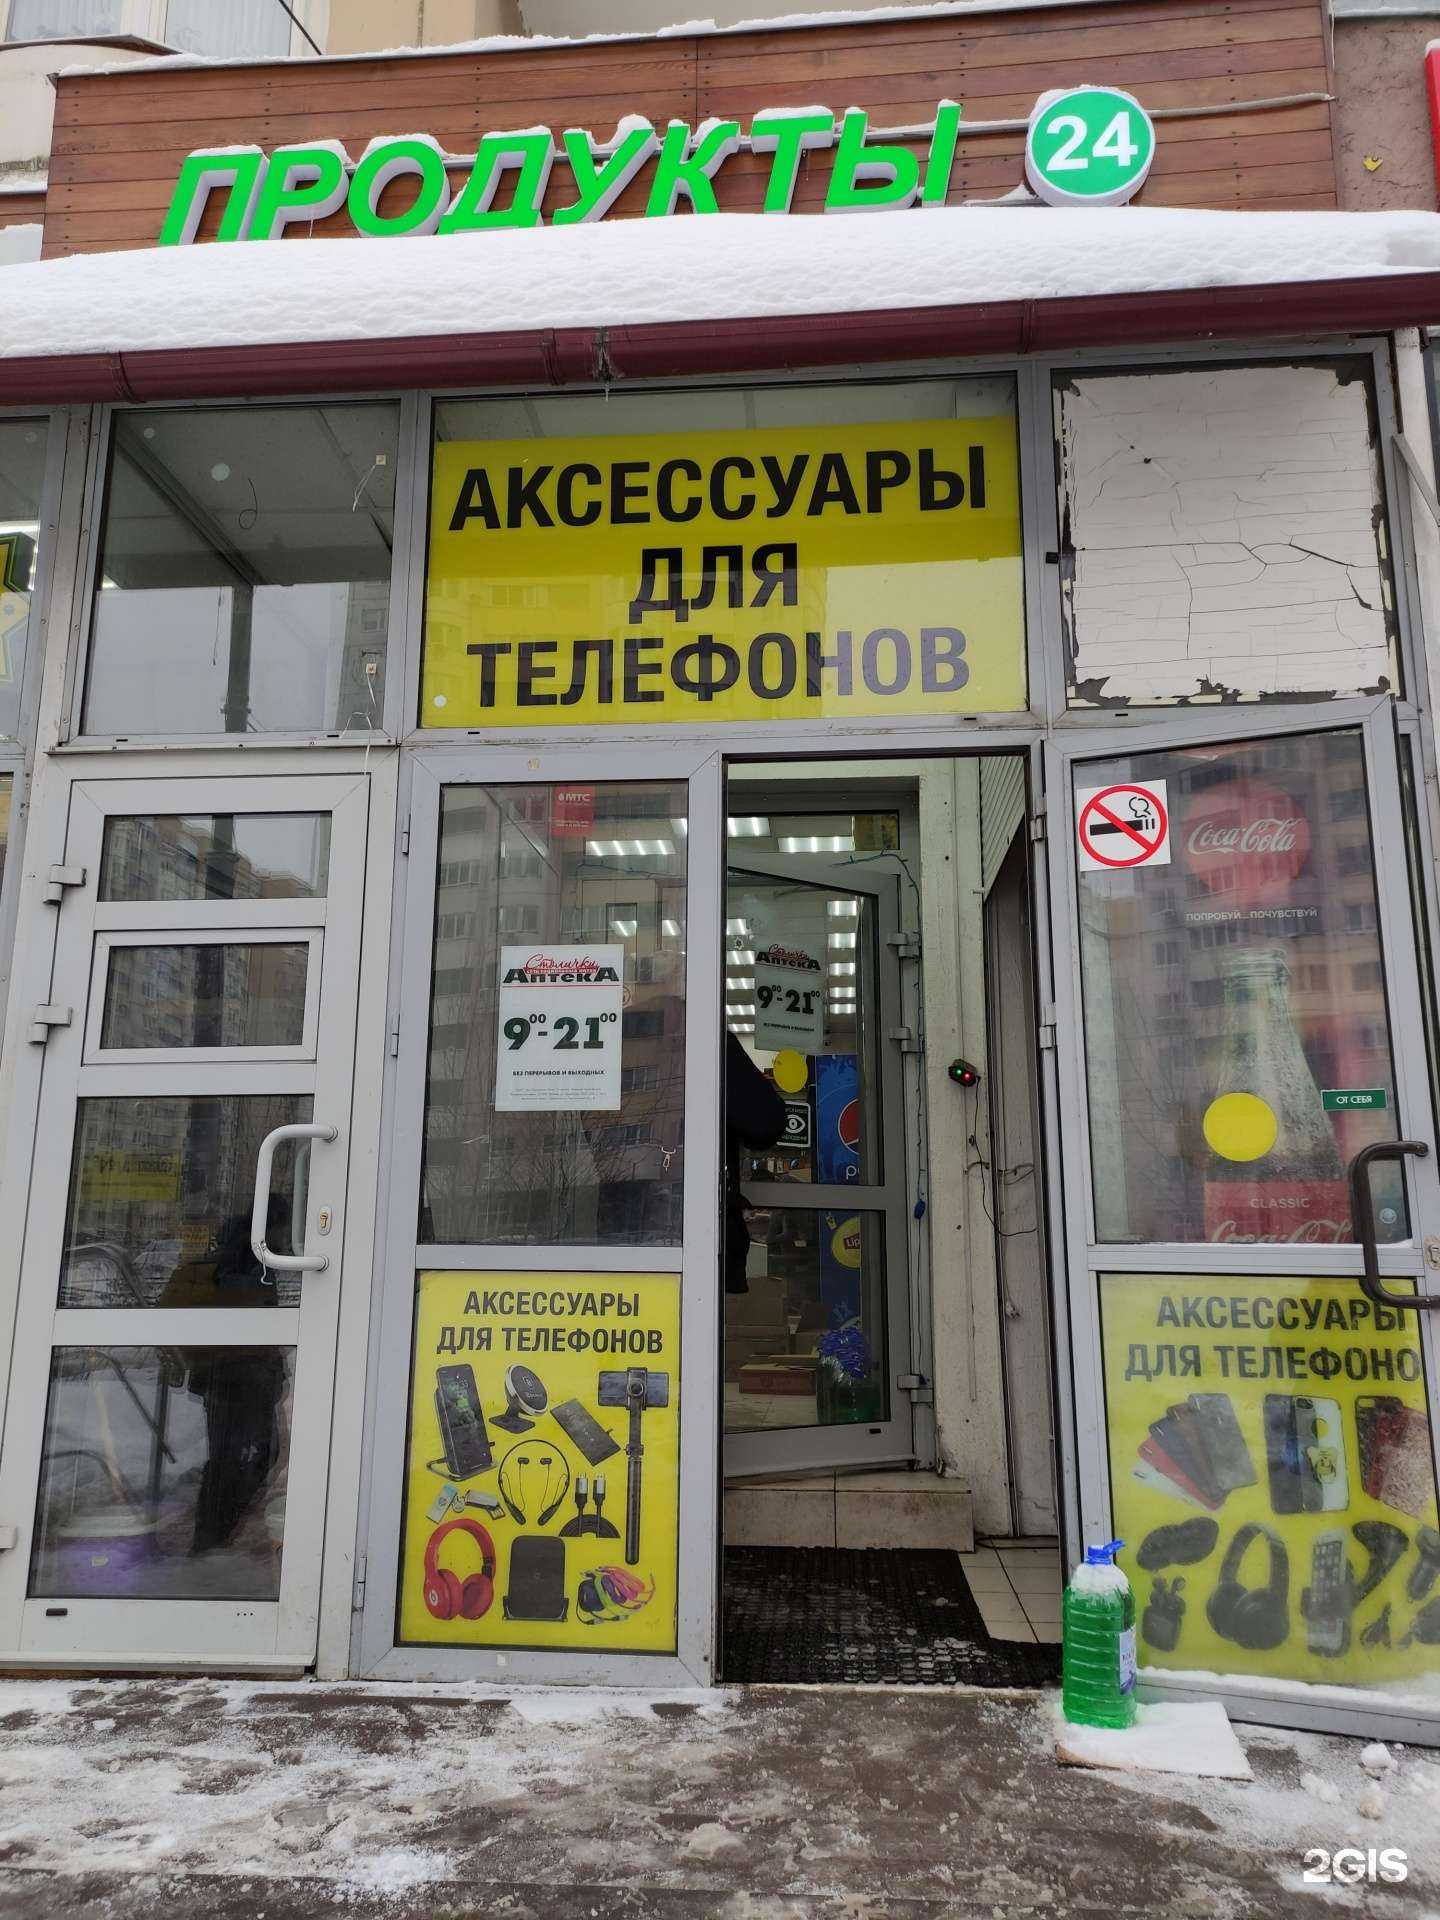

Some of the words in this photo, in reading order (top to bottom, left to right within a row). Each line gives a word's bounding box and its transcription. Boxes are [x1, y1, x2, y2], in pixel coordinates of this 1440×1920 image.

[159, 103, 961, 247] ПРОДУКТЫ
[1046, 111, 1139, 171] 24
[448, 445, 986, 531] АКСЕССУАРЫ
[628, 542, 799, 624] ДЛЯ
[466, 626, 970, 708] ТЕЛЕФОНОВ
[1188, 818, 1303, 855] Coca-Cola
[1336, 1096, 1349, 1104] ОТ
[1350, 1095, 1373, 1104] СЕБЯ
[1250, 1198, 1310, 1209] CLASSIC
[463, 1291, 640, 1317] АКСЕССУАРЫ
[1156, 1296, 1405, 1331] АКСЕССУАРЫ
[436, 1326, 493, 1355] ДЛЯ
[501, 1328, 663, 1354] ТЕЛЕФОНОВ
[1124, 1343, 1202, 1382] ДЛЯ
